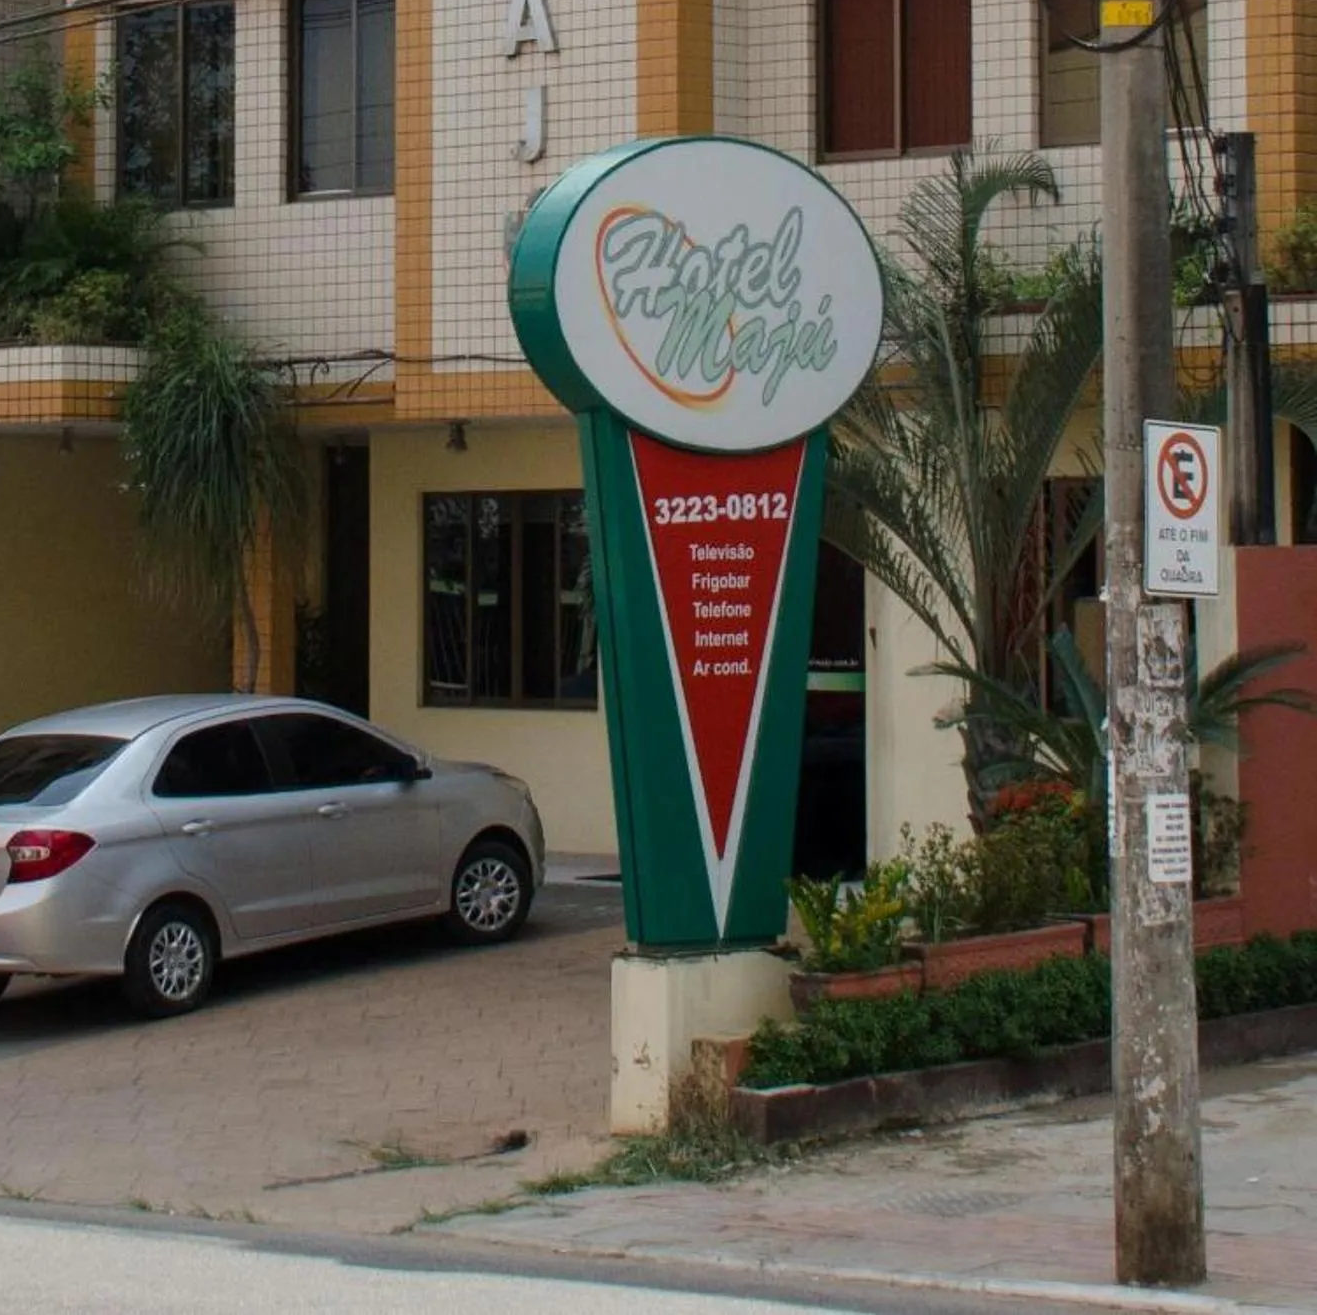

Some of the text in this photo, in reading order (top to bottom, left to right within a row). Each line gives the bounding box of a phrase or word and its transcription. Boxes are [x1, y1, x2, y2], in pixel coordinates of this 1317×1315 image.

[602, 205, 804, 319] Hotel
[653, 492, 789, 525] 3223-0812
[688, 543, 755, 561] Televisão
[691, 573, 751, 593] Frigobar
[692, 602, 751, 618] Telefone
[695, 630, 749, 647] Internet
[692, 658, 752, 677] Ar cond.
